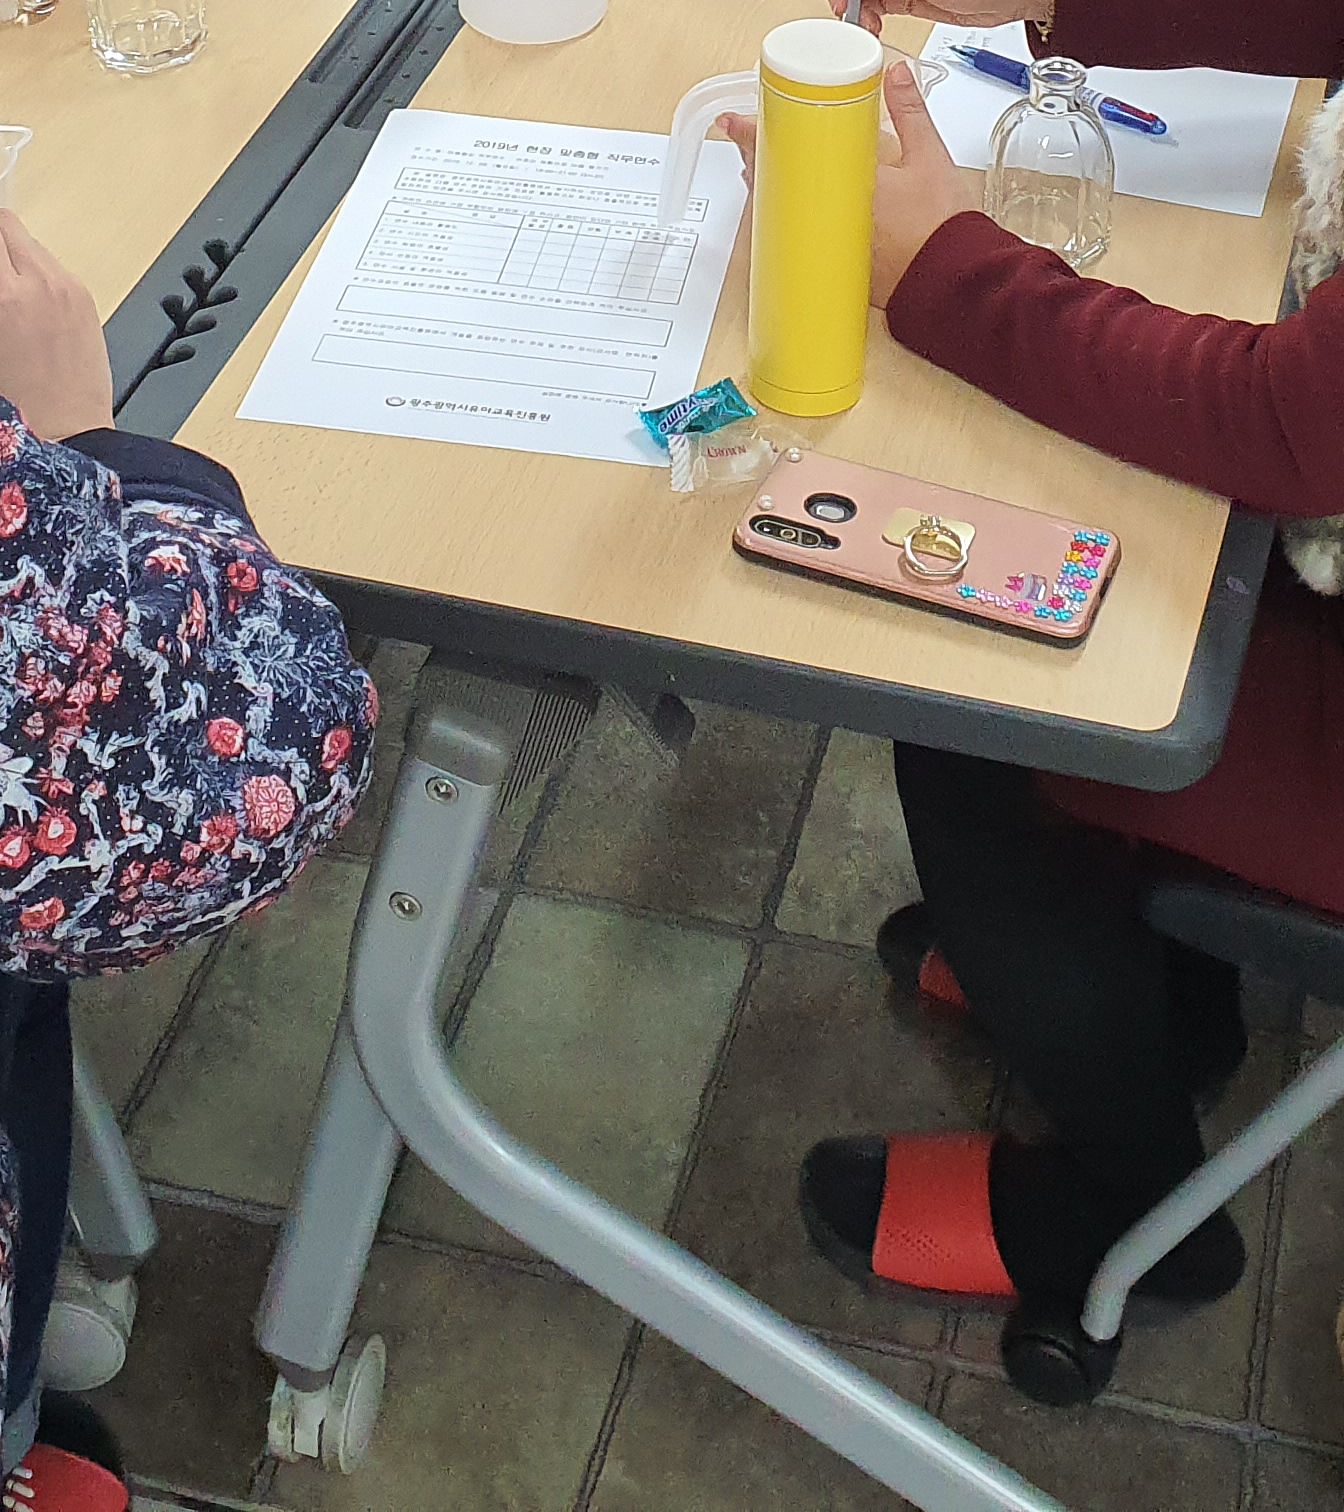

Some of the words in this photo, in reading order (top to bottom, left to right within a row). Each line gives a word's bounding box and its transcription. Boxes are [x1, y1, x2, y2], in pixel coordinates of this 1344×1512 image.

[473, 139, 519, 152] 2019년
[526, 144, 553, 156] 현장
[560, 148, 600, 160] 맞춤형
[607, 153, 661, 167] 직무연수
[409, 397, 552, 422] 광주광역시유아교육진흥원
